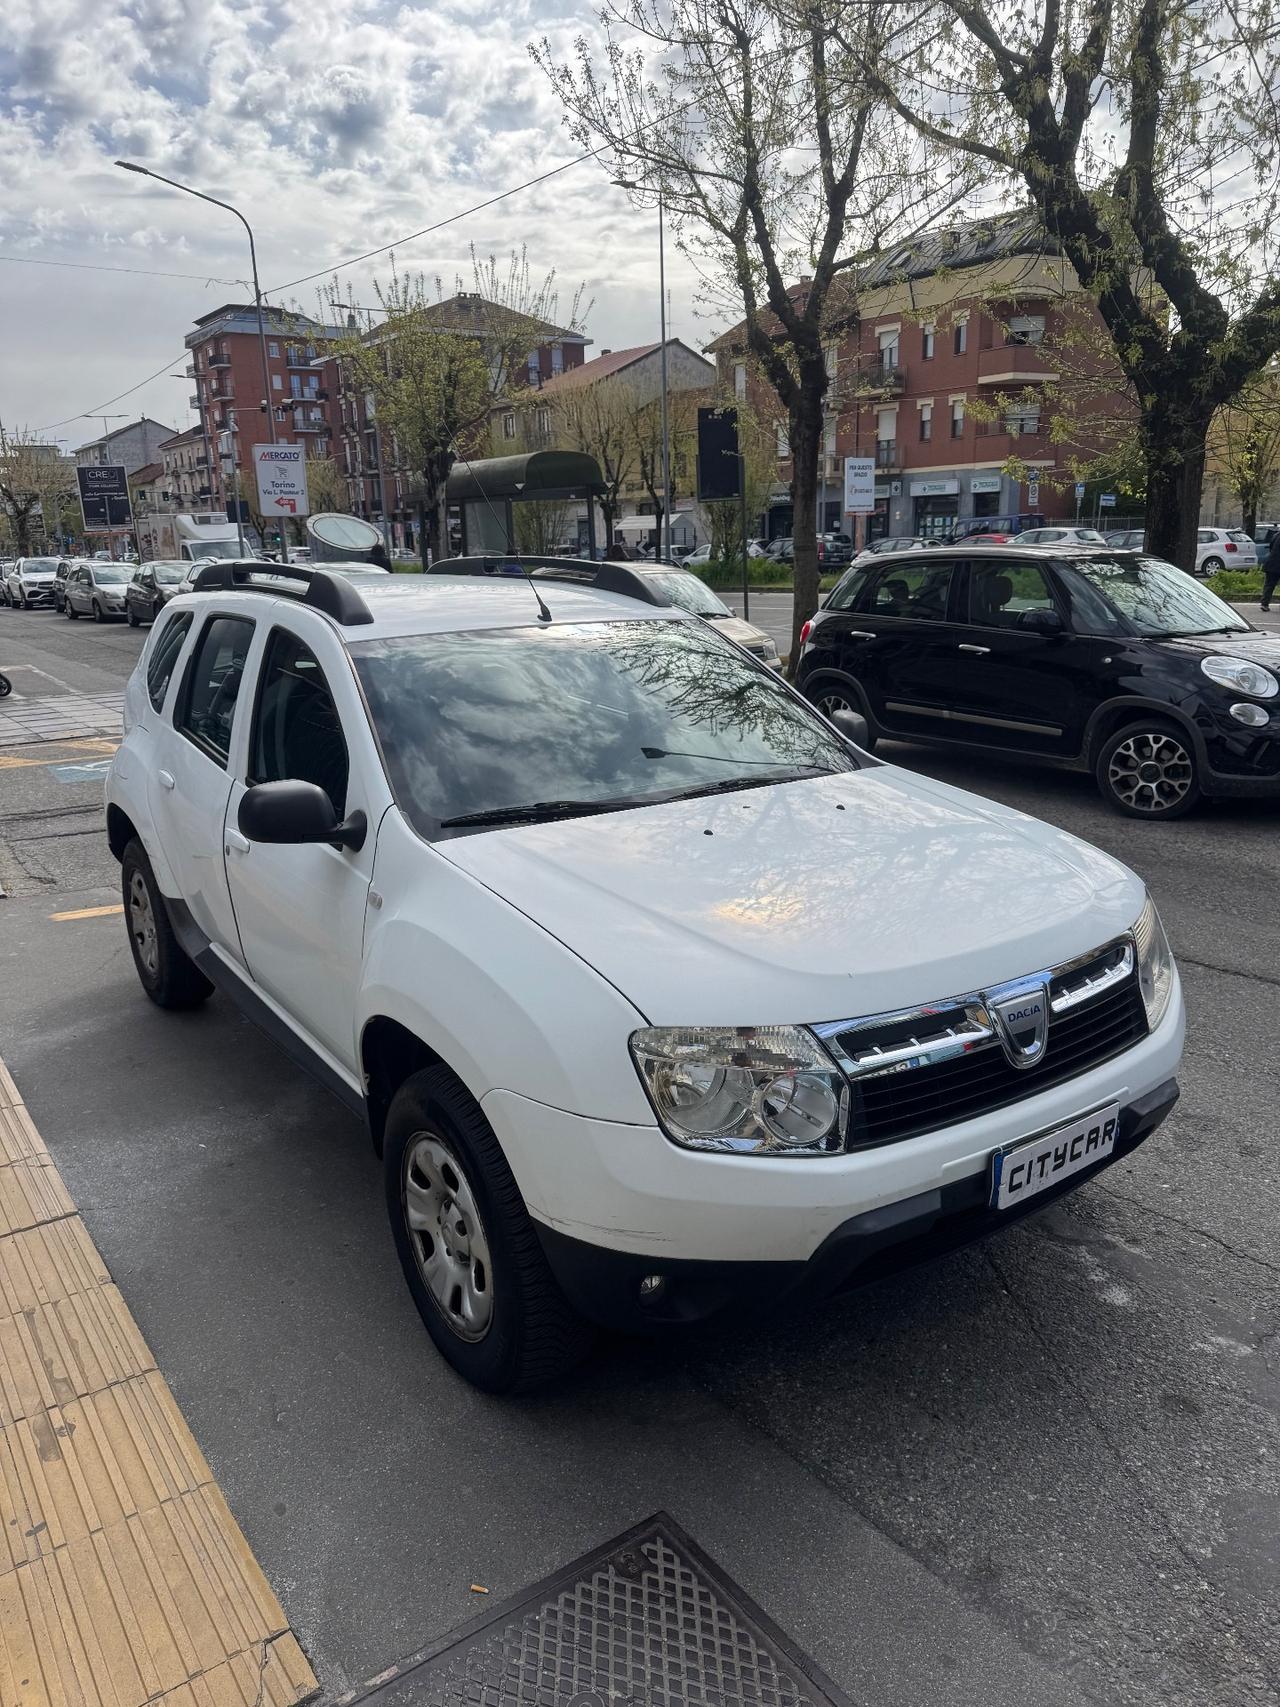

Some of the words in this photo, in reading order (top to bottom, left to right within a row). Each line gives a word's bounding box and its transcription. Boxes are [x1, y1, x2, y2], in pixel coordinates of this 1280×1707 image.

[260, 452, 300, 460] MERCATO
[1008, 1004, 1041, 1023] DACIA
[1008, 1118, 1116, 1194] CITYCAR
